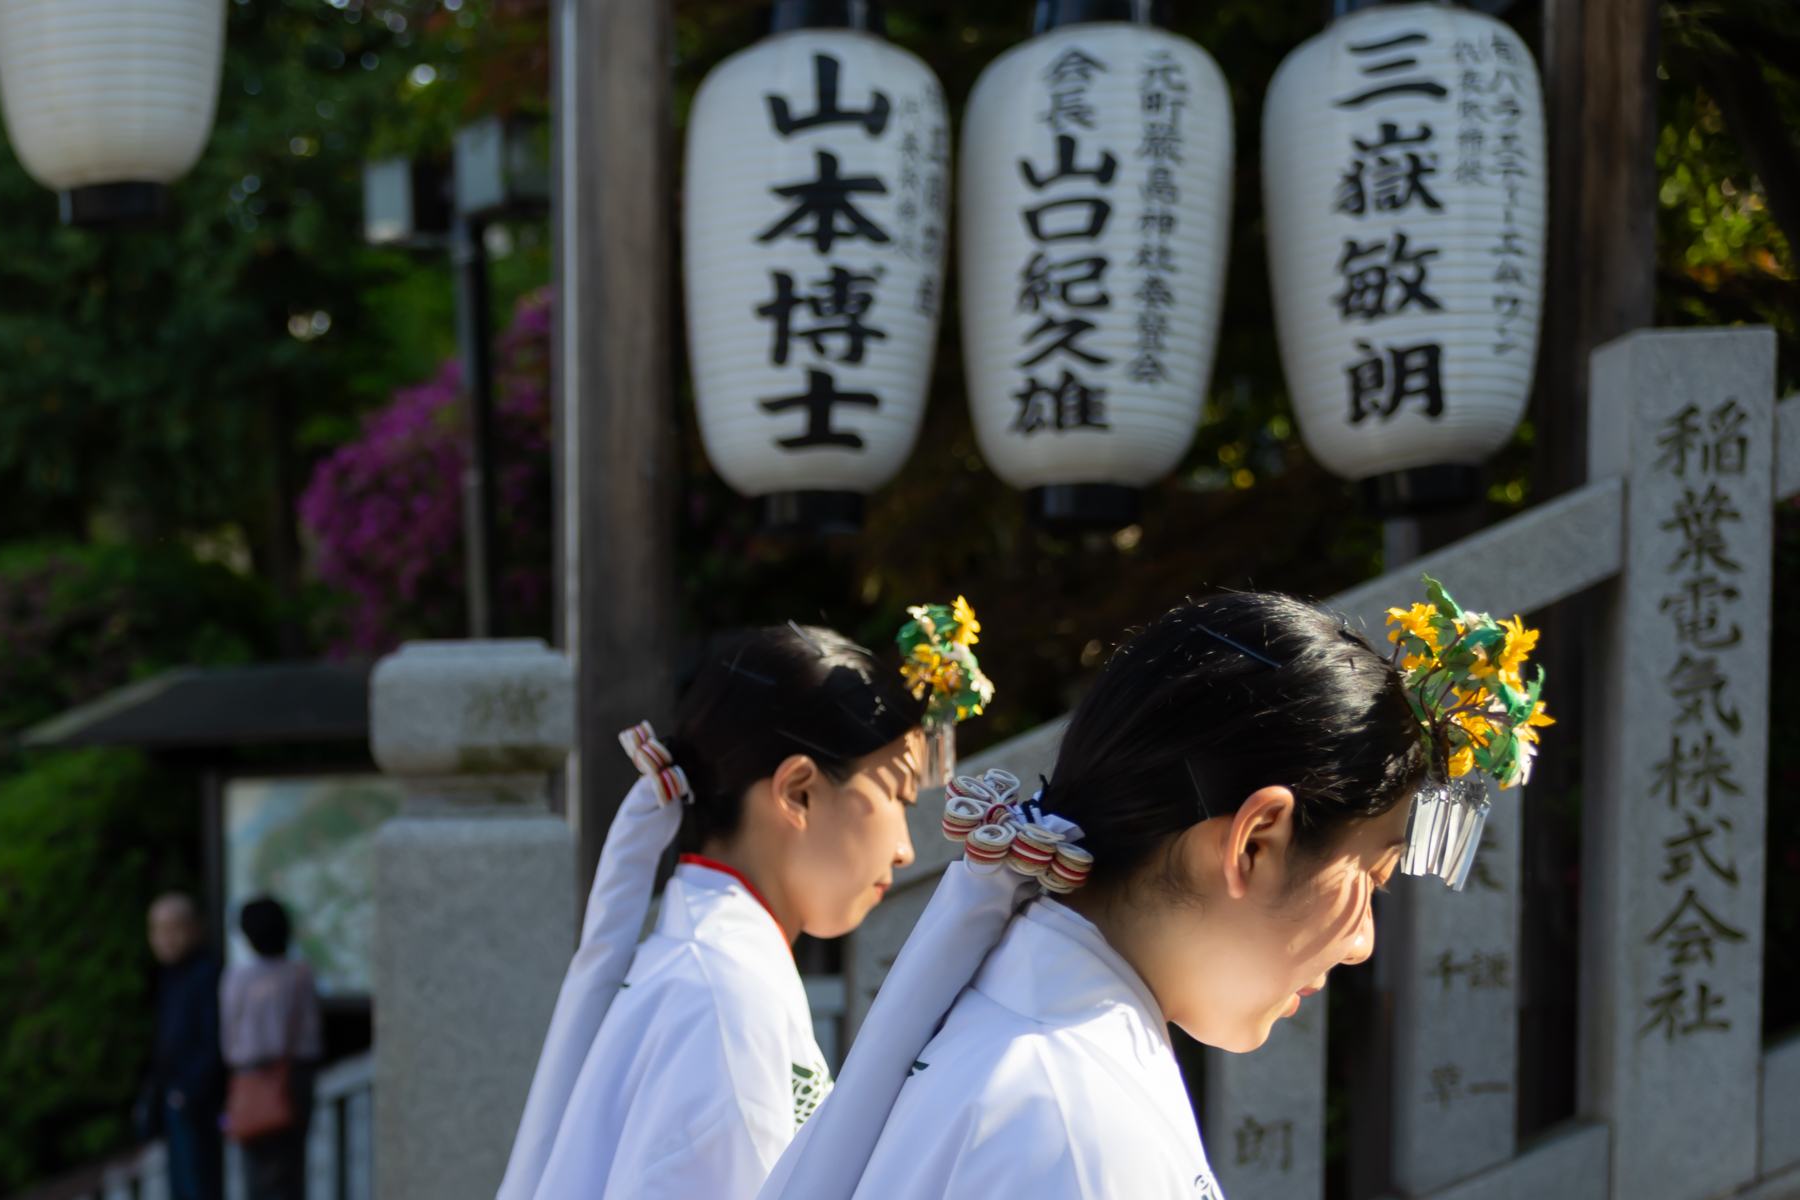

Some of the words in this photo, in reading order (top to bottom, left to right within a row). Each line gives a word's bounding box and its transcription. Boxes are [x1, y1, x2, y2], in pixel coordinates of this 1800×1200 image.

[755, 53, 890, 453] 山本博士
[1334, 34, 1448, 423] 三嶽敏朗
[1641, 400, 1749, 1043] 稲葉電気株式会社
